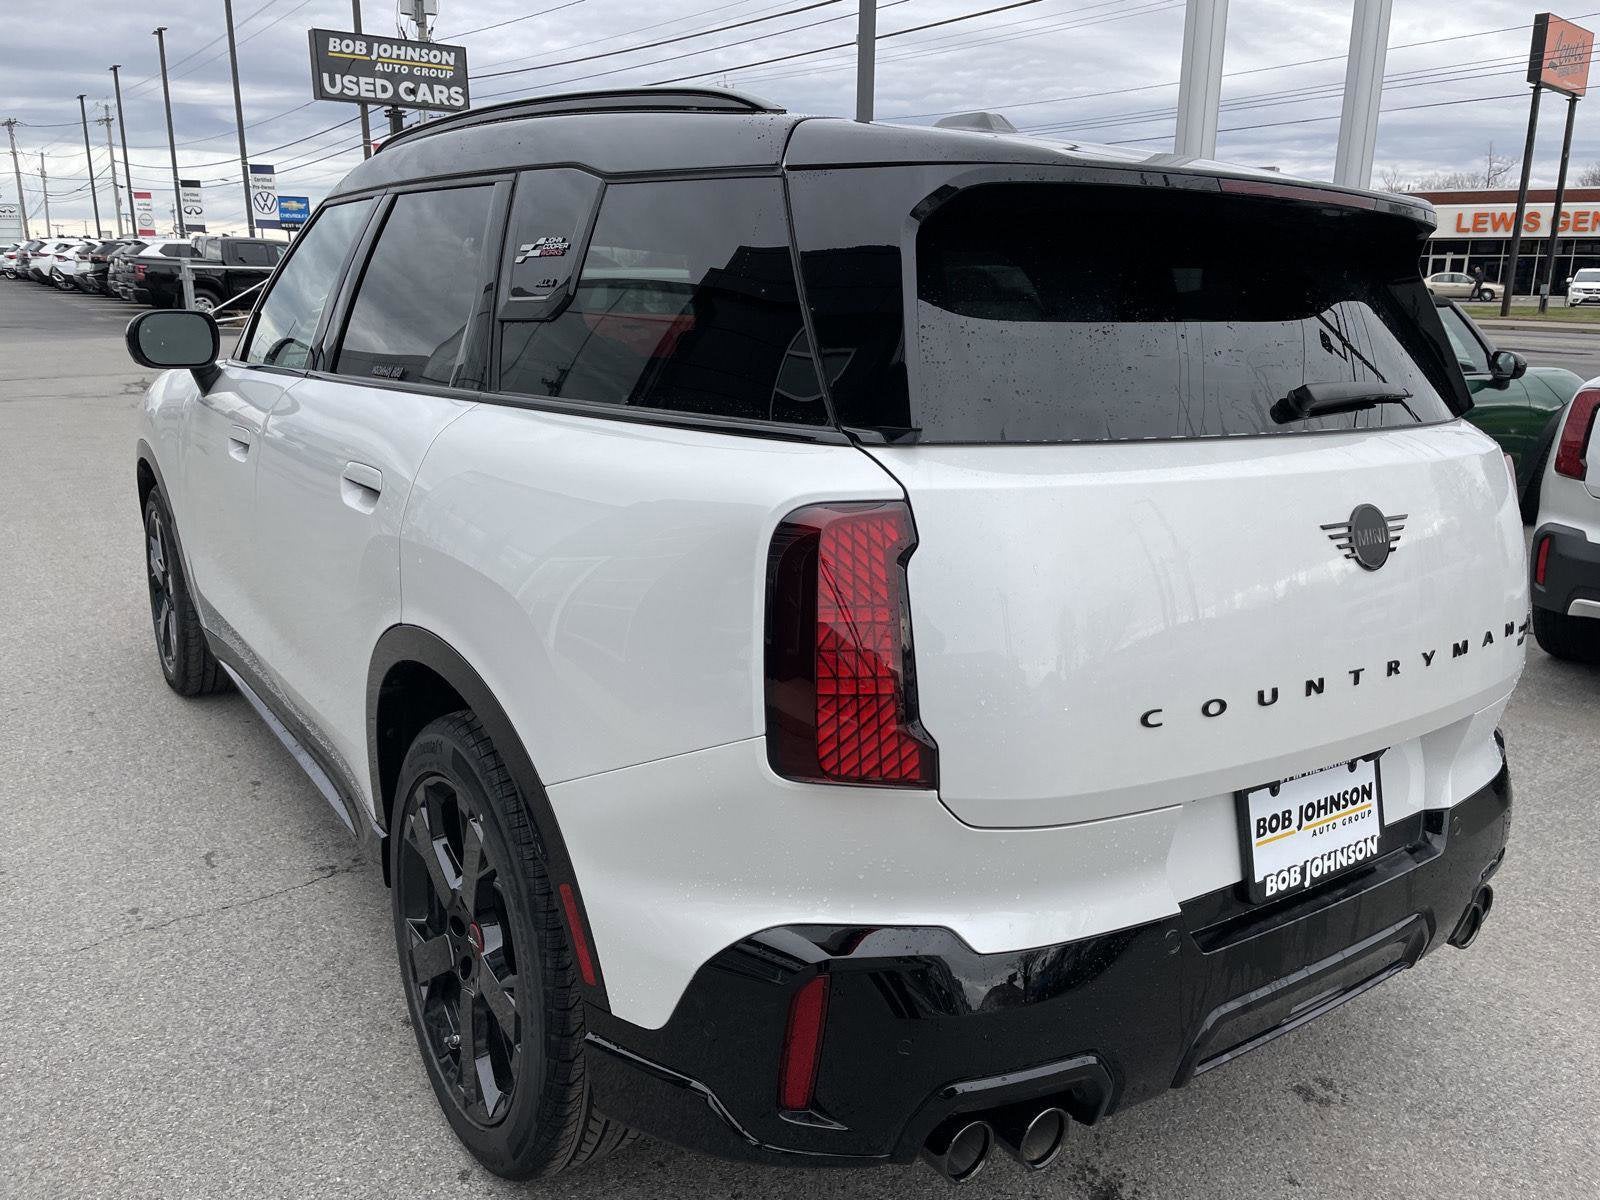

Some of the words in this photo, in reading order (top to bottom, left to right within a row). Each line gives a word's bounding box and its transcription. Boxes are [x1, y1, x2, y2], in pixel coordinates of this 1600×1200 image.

[328, 37, 367, 55] BOB
[370, 42, 455, 66] JOHNSON
[375, 63, 409, 74] AUTO
[413, 67, 454, 79] GROUP
[322, 72, 394, 99] USED
[398, 81, 465, 107] CARS
[1455, 211, 1541, 233] LEWS
[543, 242, 568, 250] COOPER
[1357, 527, 1386, 547] MINI
[1140, 621, 1515, 729] COUNTRYMAN
[1256, 809, 1293, 839] BOB
[1296, 782, 1373, 832] JOHNSON
[1312, 822, 1337, 838] AUTO
[1342, 809, 1372, 826] GROUP
[1265, 865, 1301, 897] BOB
[1304, 835, 1378, 888] JOHNSON
